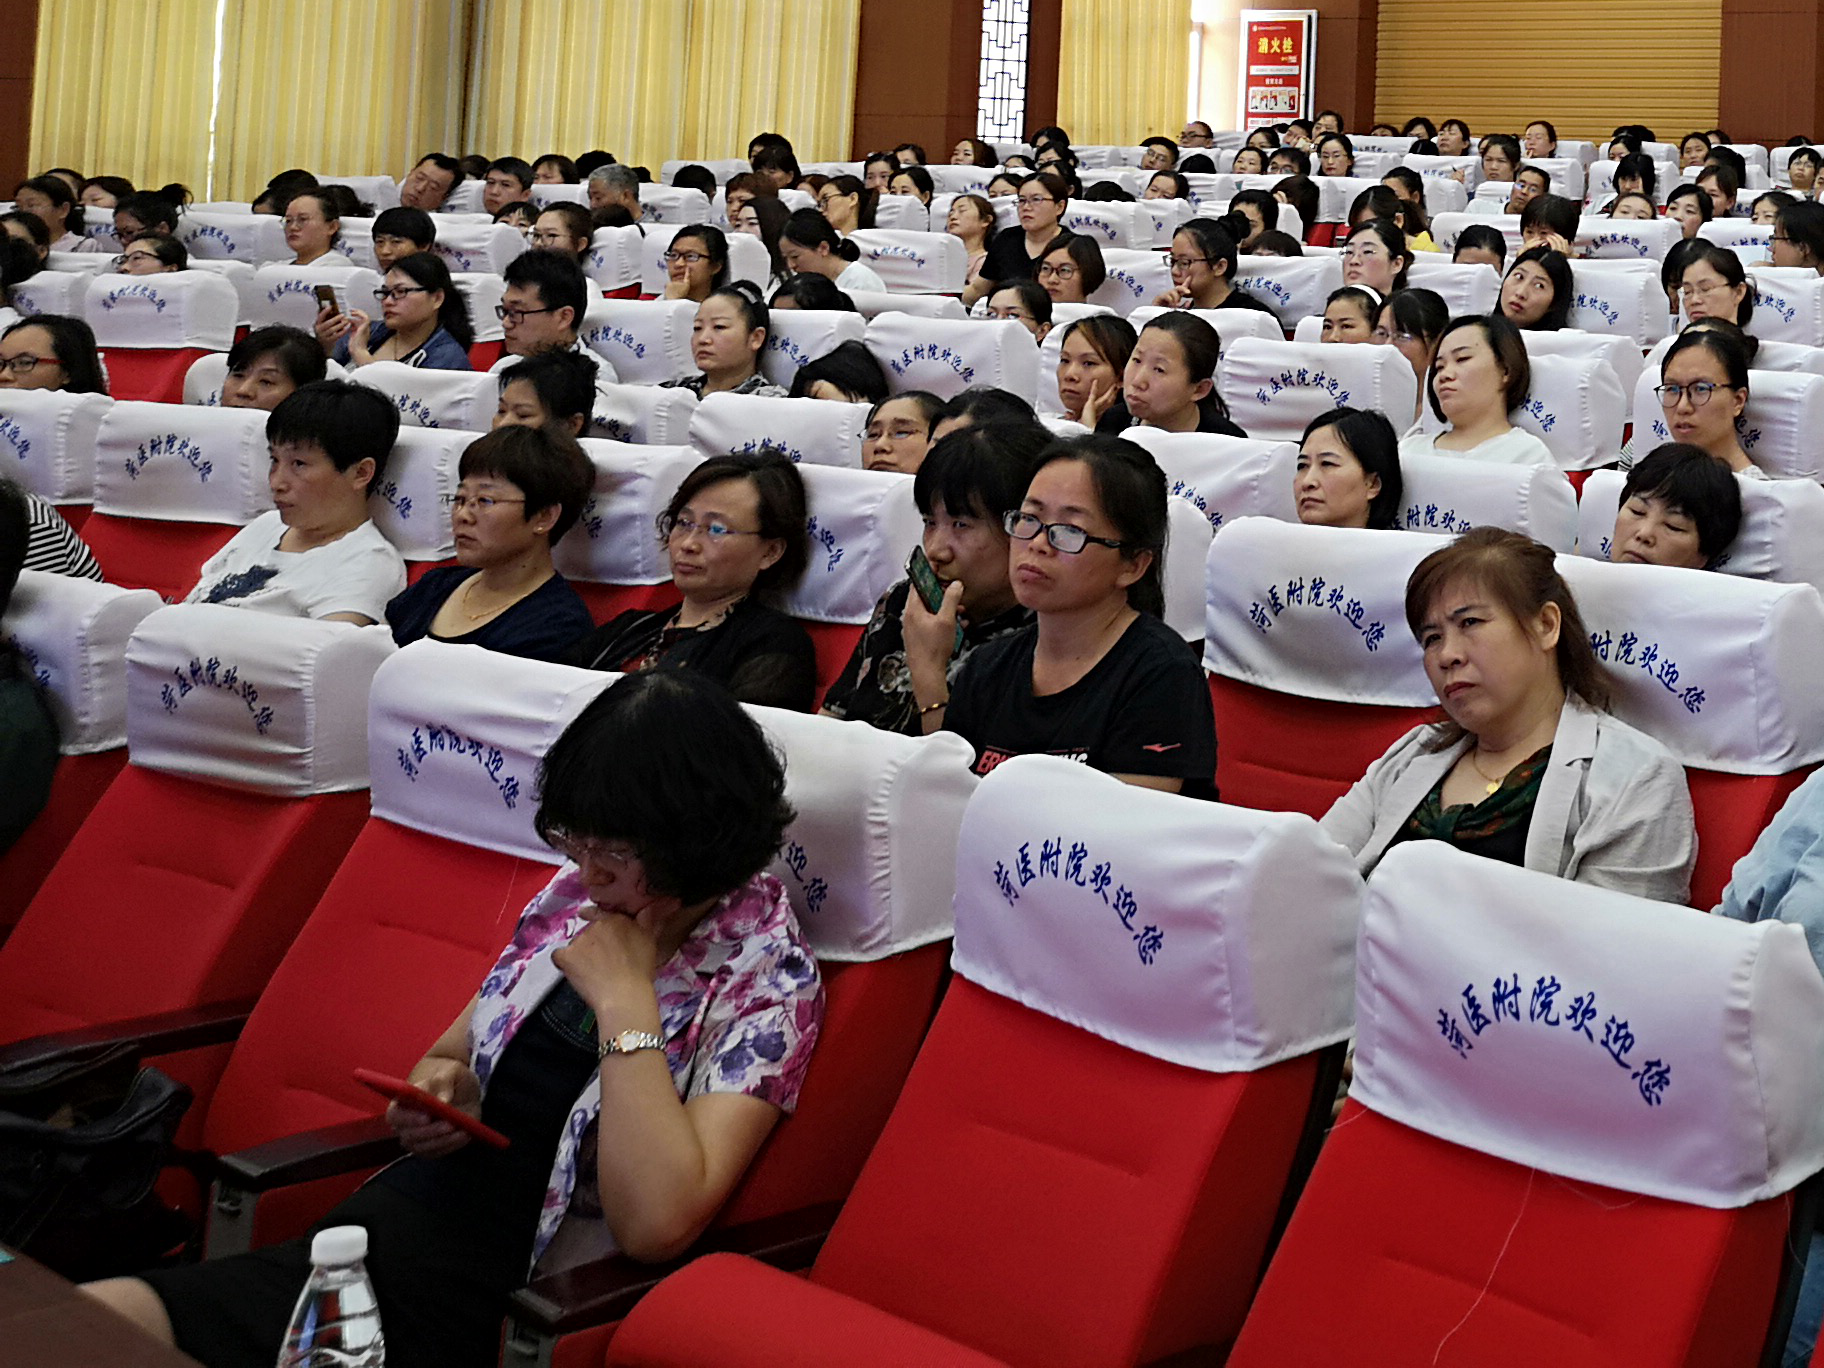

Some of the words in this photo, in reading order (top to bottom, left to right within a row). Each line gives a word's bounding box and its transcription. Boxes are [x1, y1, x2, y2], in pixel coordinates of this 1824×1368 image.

[1252, 577, 1386, 652] 菏医附院欢迎您
[993, 839, 1163, 965] 菏医附院欢迎您
[1437, 973, 1672, 1108] 菏医附院欢迎您
